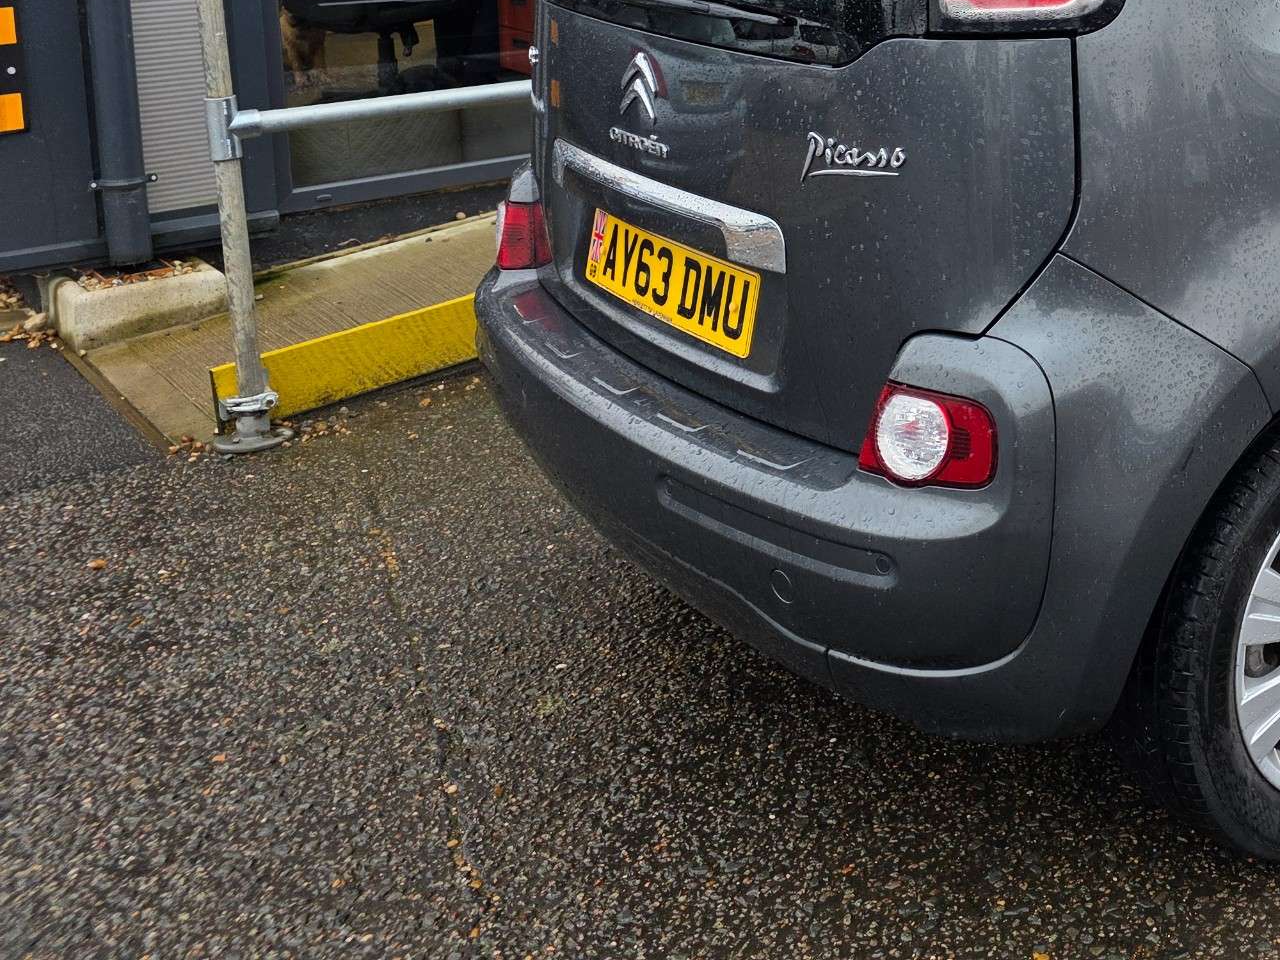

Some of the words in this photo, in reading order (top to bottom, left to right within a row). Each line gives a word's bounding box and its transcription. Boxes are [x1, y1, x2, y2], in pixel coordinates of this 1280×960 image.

[800, 131, 906, 182] Picasso
[603, 223, 674, 307] AY63
[676, 256, 751, 340] DMU
